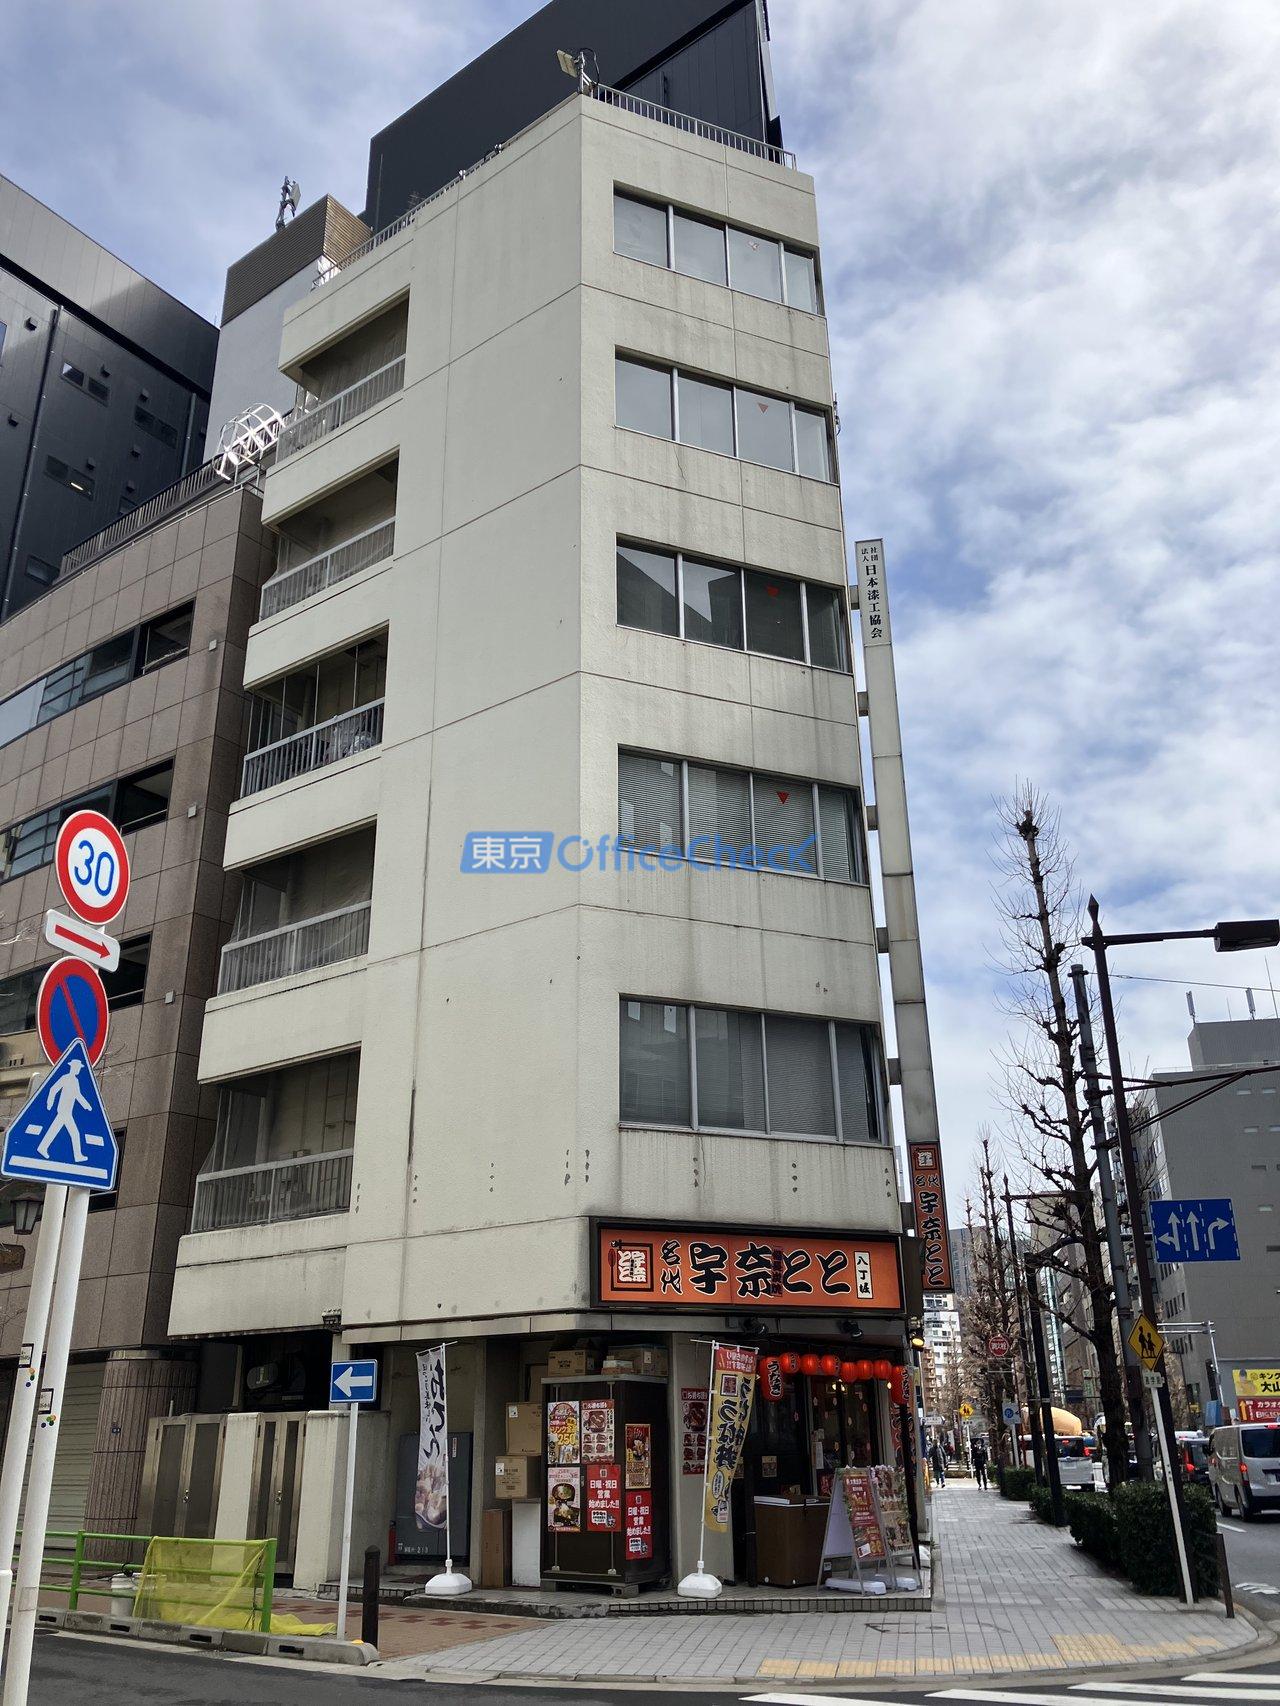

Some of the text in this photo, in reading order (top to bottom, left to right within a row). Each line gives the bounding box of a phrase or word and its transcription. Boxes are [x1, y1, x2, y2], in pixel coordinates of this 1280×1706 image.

[865, 564, 883, 639] 日本漆工協会
[74, 839, 115, 897] 30
[857, 1255, 871, 1295] 八丁堀
[768, 1360, 781, 1397] うなぎ
[590, 1480, 618, 1489] 日曜・祝日
